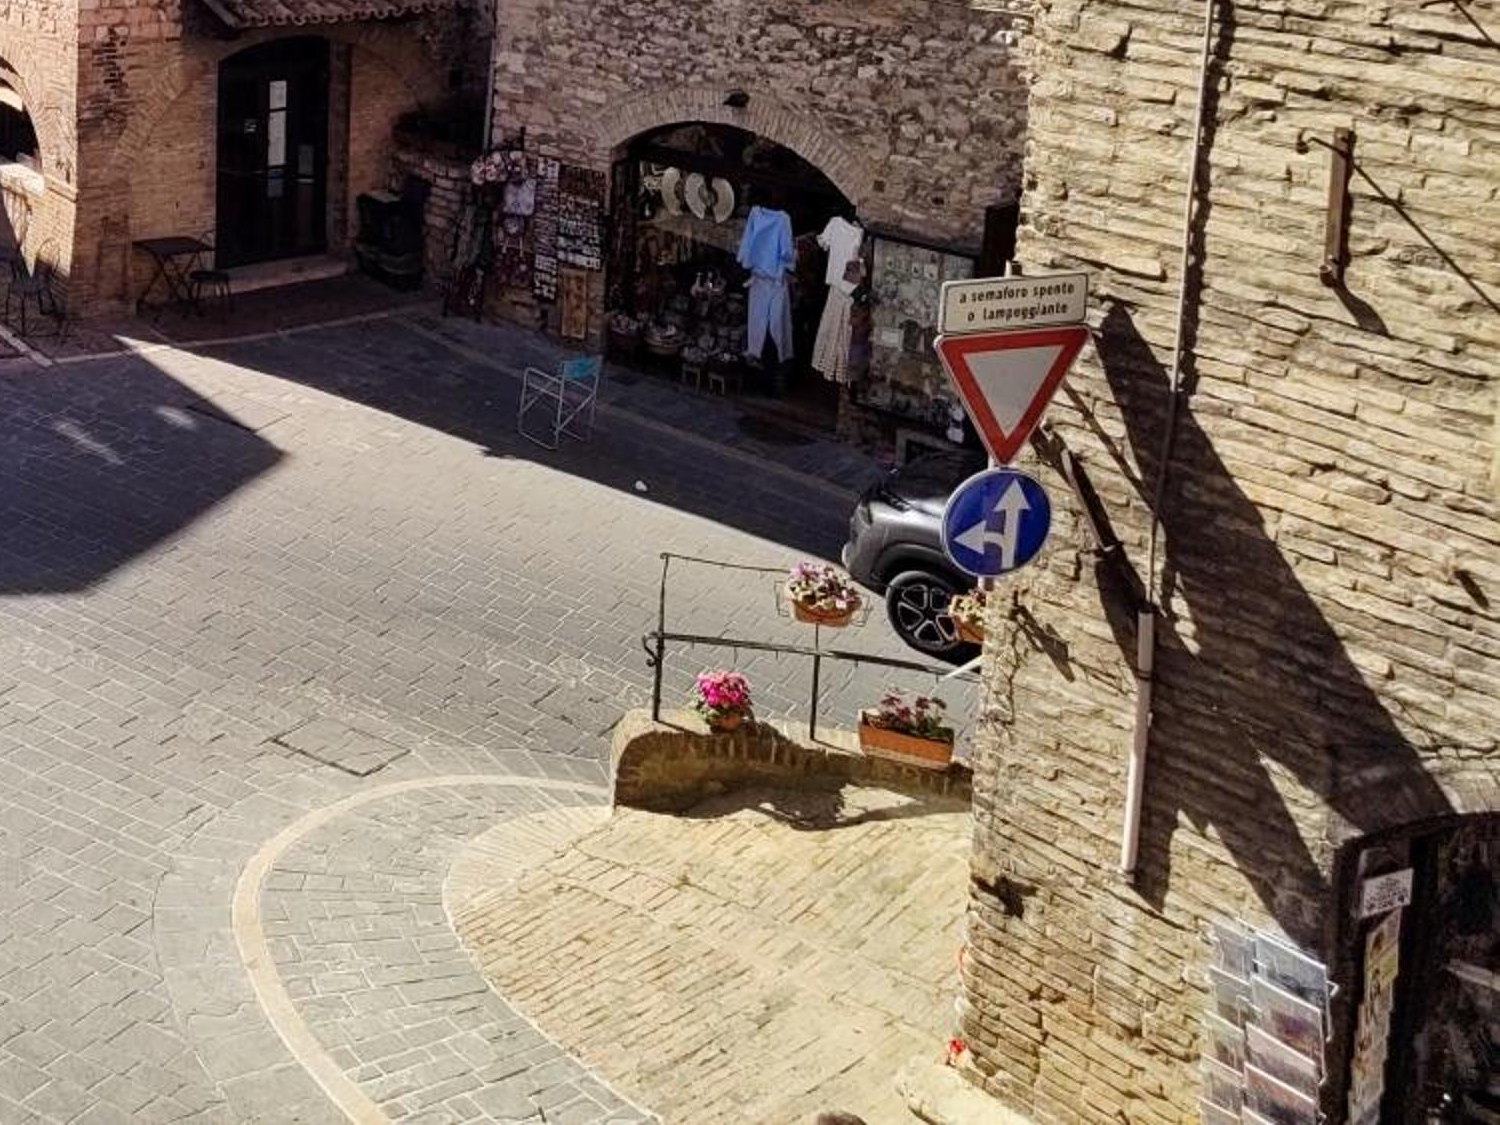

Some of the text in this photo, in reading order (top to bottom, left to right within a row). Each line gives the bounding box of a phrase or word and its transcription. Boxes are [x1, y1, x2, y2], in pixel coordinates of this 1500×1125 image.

[959, 282, 1075, 304] a semaforo spento
[967, 302, 1068, 322] o lampeggiante
